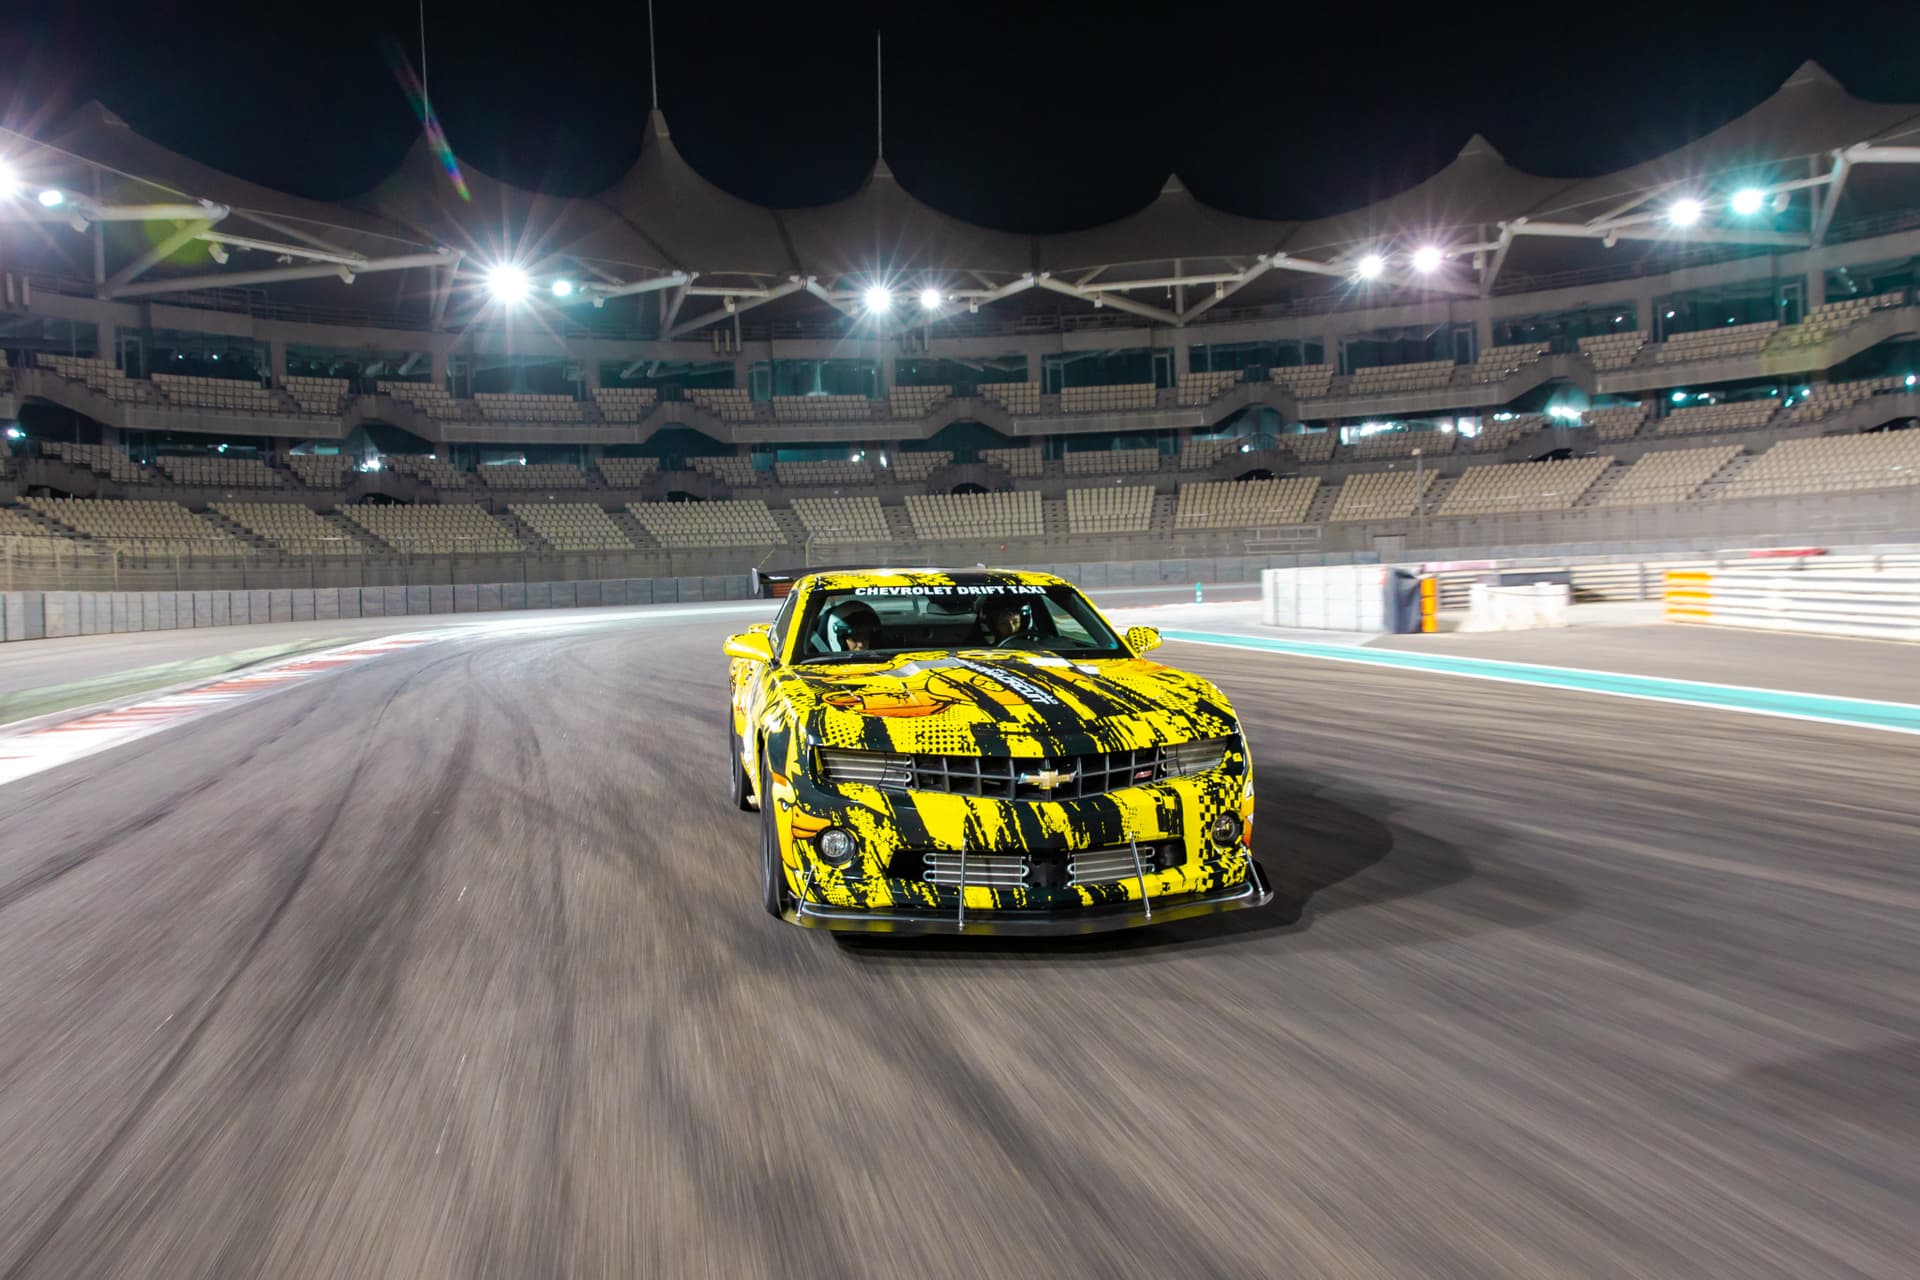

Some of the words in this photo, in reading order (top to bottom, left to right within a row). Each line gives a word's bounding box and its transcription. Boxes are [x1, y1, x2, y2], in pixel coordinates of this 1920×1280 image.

[855, 587, 952, 596] CHEVROLET
[957, 586, 1005, 595] DRIFT
[1007, 586, 1047, 594] TAXI
